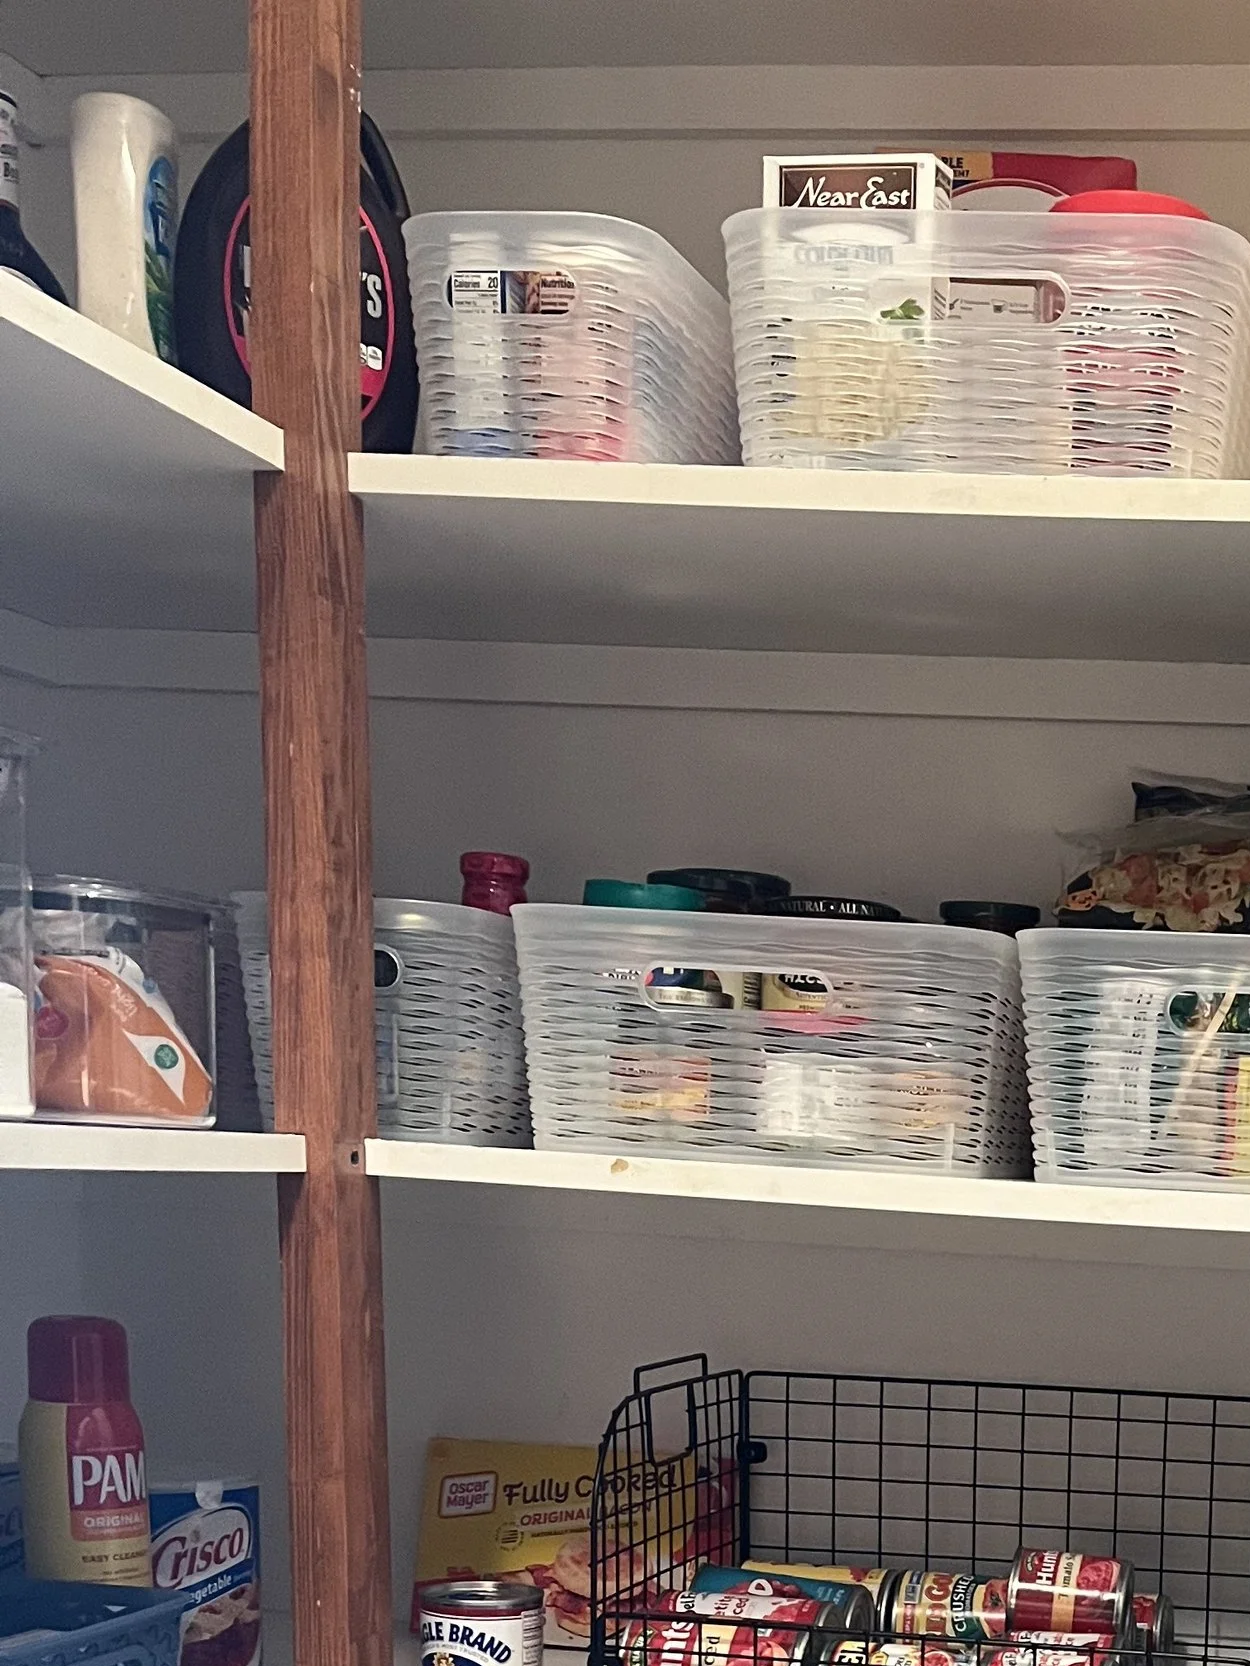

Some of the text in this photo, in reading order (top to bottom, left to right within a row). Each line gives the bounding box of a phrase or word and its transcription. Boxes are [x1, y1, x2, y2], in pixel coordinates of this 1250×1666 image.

[787, 176, 911, 210] Near East
[488, 276, 499, 288] 20
[838, 902, 858, 914] ALL
[72, 1451, 146, 1505] PAM
[450, 1478, 489, 1494] Oscar
[503, 1478, 570, 1506] Fully
[446, 1491, 489, 1509] Mayer
[152, 1527, 244, 1590] Crisco
[953, 1575, 974, 1632] CRUSHED
[448, 1622, 512, 1663] BRAND
